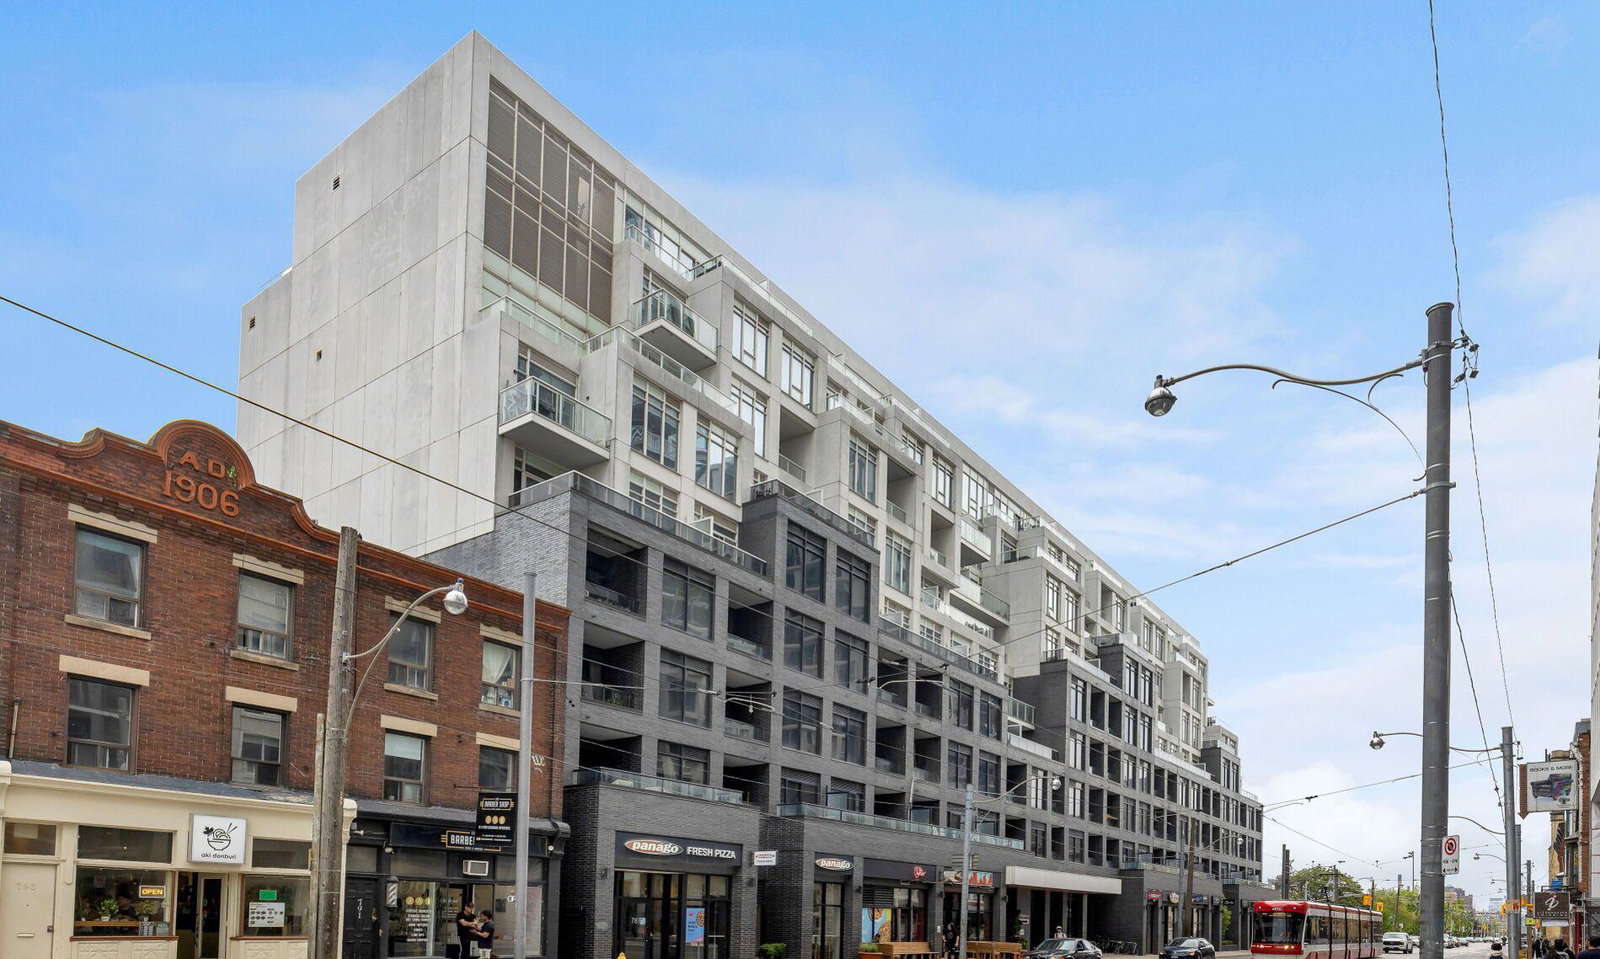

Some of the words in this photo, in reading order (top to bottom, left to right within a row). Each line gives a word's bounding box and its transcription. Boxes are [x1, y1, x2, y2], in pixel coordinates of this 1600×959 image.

[162, 470, 240, 517] 1906
[631, 841, 679, 854] panago
[686, 846, 713, 857] FRESH
[714, 848, 736, 859] PIZZA
[820, 860, 851, 869] panago
